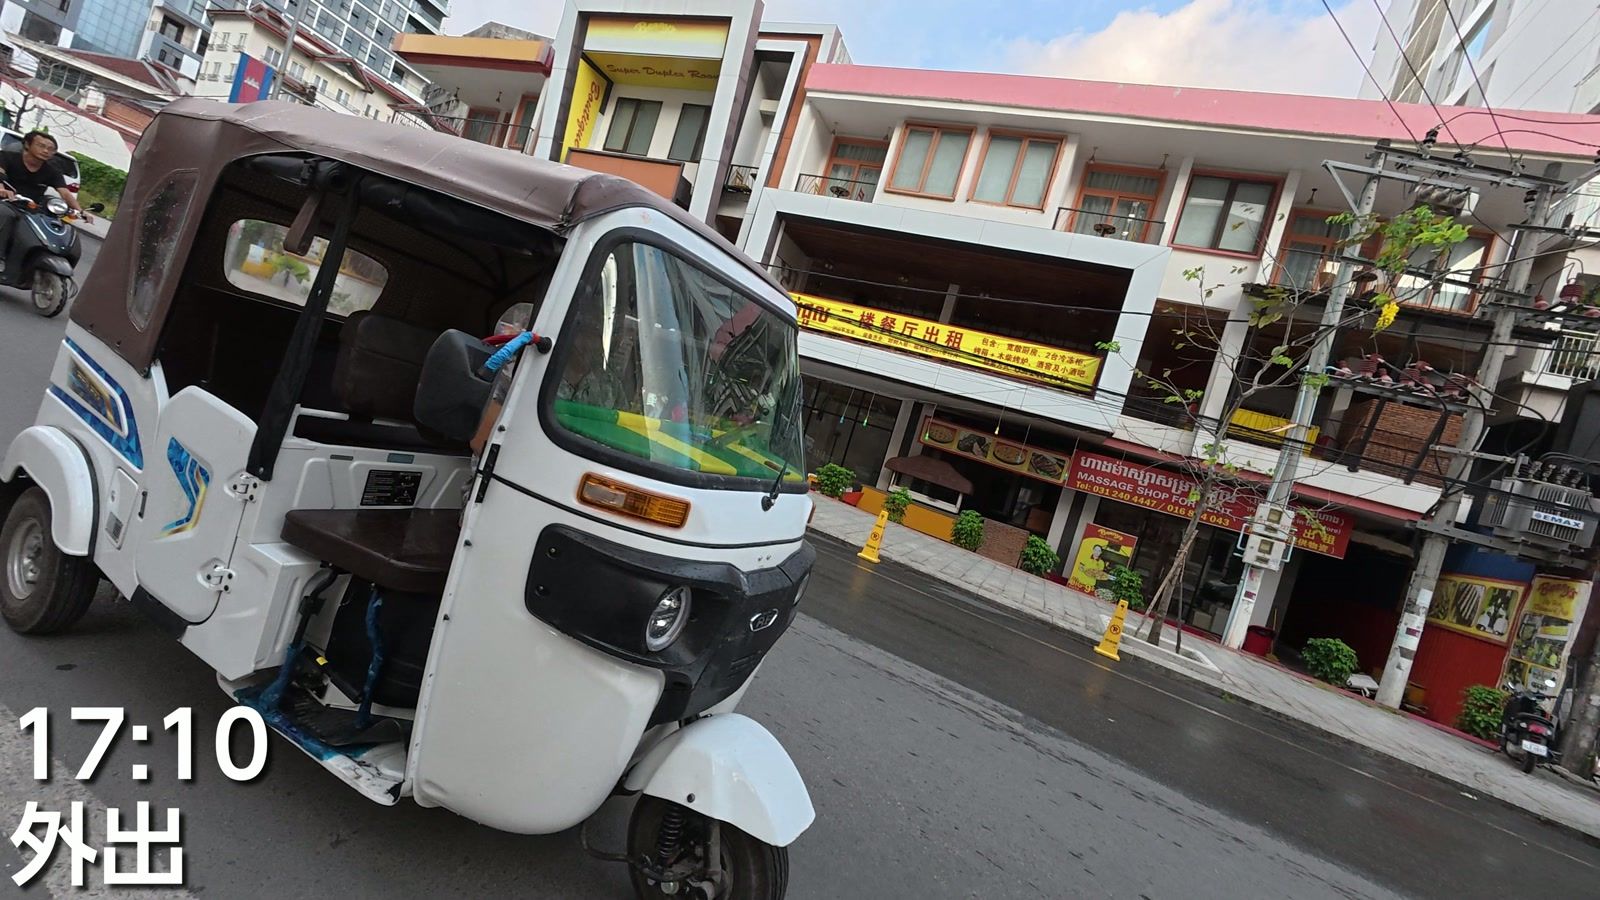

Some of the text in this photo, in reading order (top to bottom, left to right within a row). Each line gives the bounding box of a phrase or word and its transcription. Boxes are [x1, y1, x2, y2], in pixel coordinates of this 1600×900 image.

[1076, 481, 1092, 491] Tel:
[1093, 485, 1110, 496] 031
[1112, 490, 1130, 501] 240
[1132, 495, 1157, 507] 4447
[1167, 505, 1186, 516] 016
[1188, 509, 1207, 521] 84
[1209, 516, 1230, 527] 043
[1077, 471, 1134, 493] MASSAGE
[1136, 485, 1170, 501] SHOP
[1171, 495, 1197, 508] FOR
